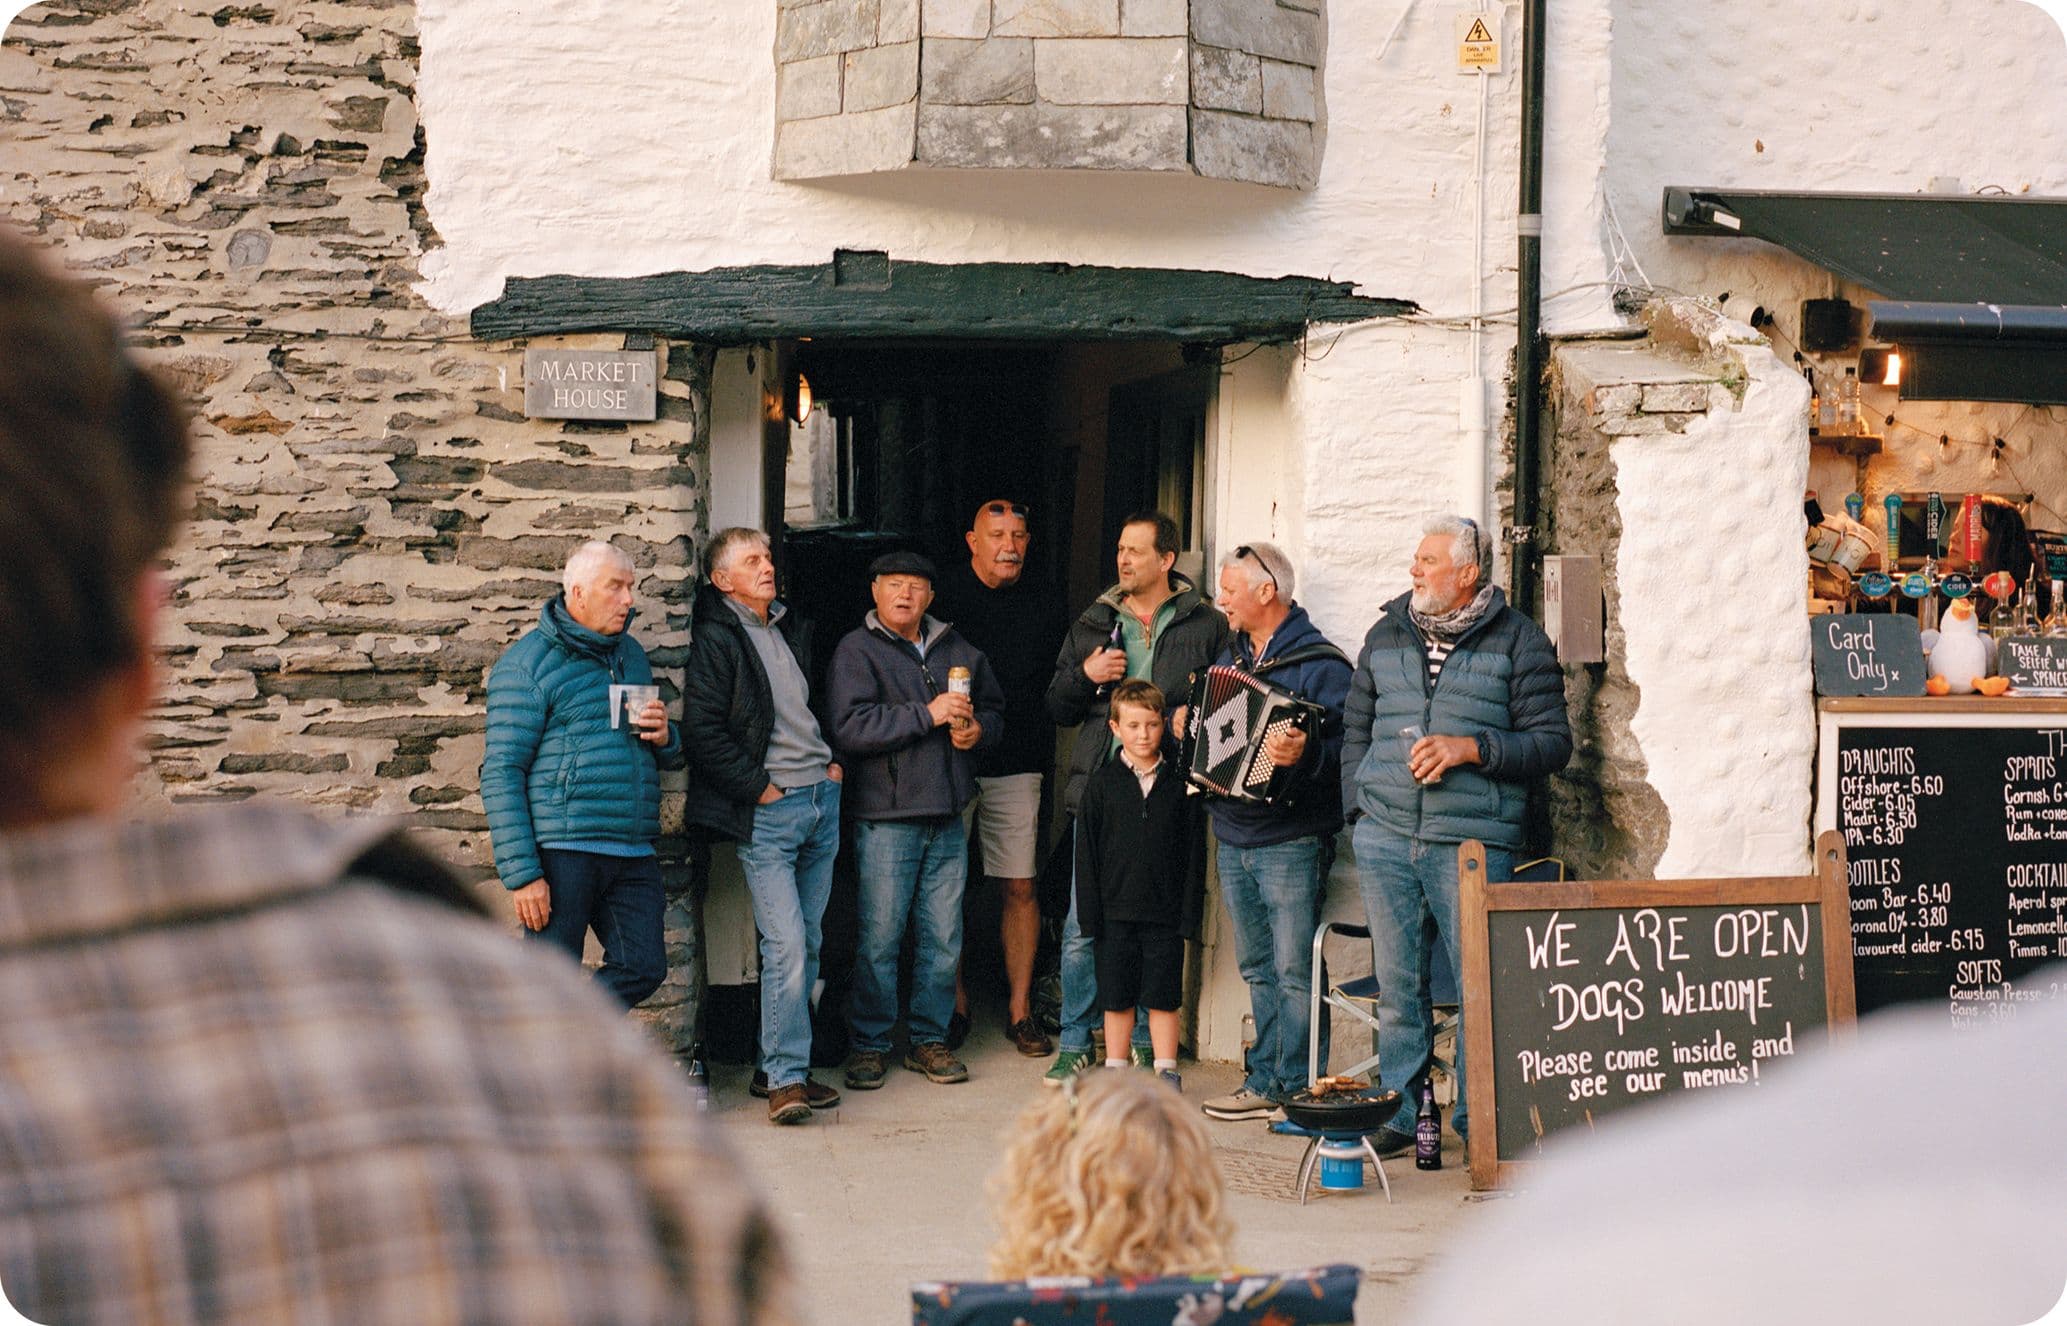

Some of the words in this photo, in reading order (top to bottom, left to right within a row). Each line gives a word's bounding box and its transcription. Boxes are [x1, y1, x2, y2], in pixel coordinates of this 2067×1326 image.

[540, 361, 641, 382] MARKET
[554, 388, 628, 410] HOUSE
[1829, 619, 1875, 651] Card
[2008, 642, 2040, 657] TAKE
[2046, 645, 2053, 658] A
[1847, 651, 1888, 691] Only
[2019, 656, 2050, 670] SELFIE
[1841, 747, 1915, 775] DRAUGHTS
[2004, 756, 2056, 782] SPIRITS
[1841, 775, 1900, 795] Offshore
[2004, 784, 2050, 804] Cornish
[1842, 794, 1876, 811] Cider
[1844, 810, 1878, 826] Madri
[2005, 805, 2033, 824] Rum
[1845, 827, 1865, 847] IPA
[2006, 823, 2041, 842] Vodka
[1848, 896, 1877, 911] oom
[1882, 886, 1908, 909] Bar
[2008, 890, 2046, 915] Aperol
[1850, 917, 1888, 933] orona
[1525, 911, 1580, 970] WE
[1605, 908, 1690, 972] ARE
[1714, 904, 1809, 958] OPEN
[1853, 933, 1906, 956] lavoured
[1911, 931, 1942, 953] cider
[2008, 939, 2048, 959] Pimms
[1956, 958, 2002, 984] SOFTS
[1950, 984, 2000, 1000] Cawston
[1548, 978, 1645, 1036] DOGS
[1660, 971, 1773, 1025] WELCOME
[1950, 1002, 1978, 1016] Cans
[1518, 1050, 1592, 1083] Please
[1605, 1046, 1660, 1072] come
[1672, 1030, 1737, 1065] inside
[1752, 1021, 1794, 1060] and
[1568, 1074, 1608, 1101] see
[1626, 1072, 1666, 1094] our
